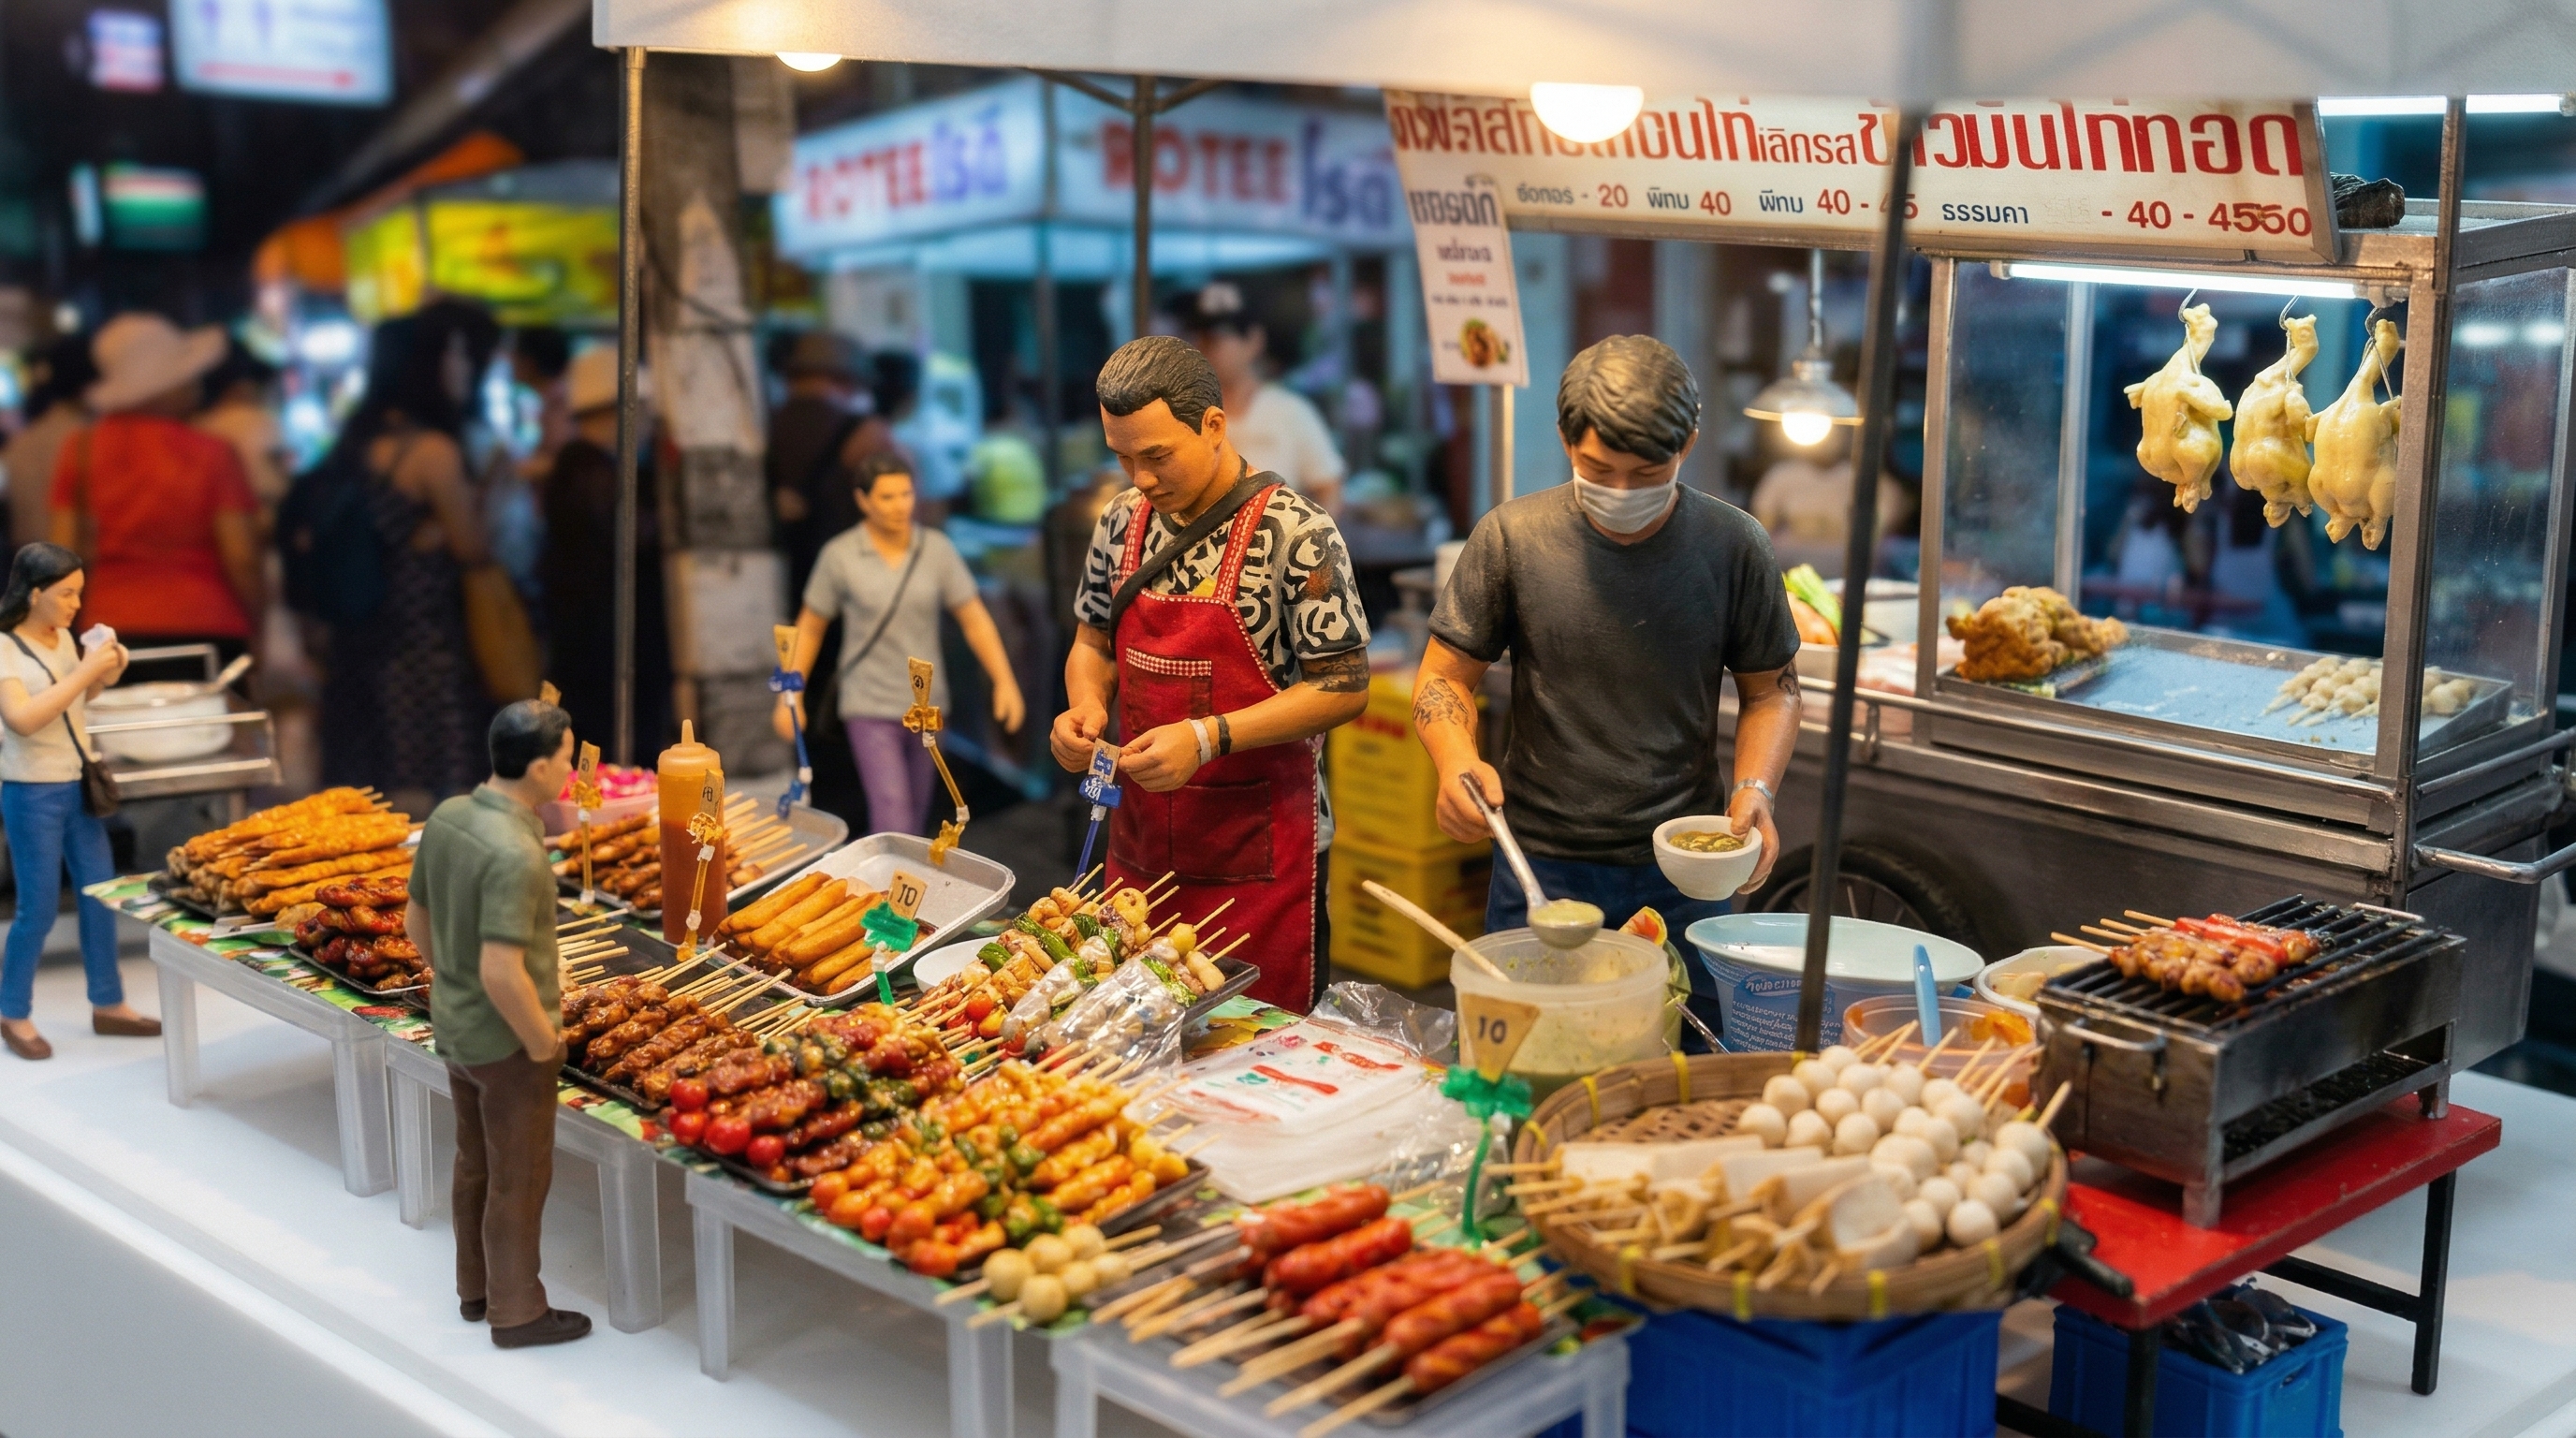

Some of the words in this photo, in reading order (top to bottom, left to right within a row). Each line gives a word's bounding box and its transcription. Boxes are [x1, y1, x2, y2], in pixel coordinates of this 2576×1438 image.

[1597, 183, 1630, 209] 20
[1700, 190, 1732, 216] 40
[1816, 188, 1852, 215] 40
[2127, 200, 2172, 229] 40
[1478, 1014, 1507, 1045] 10
